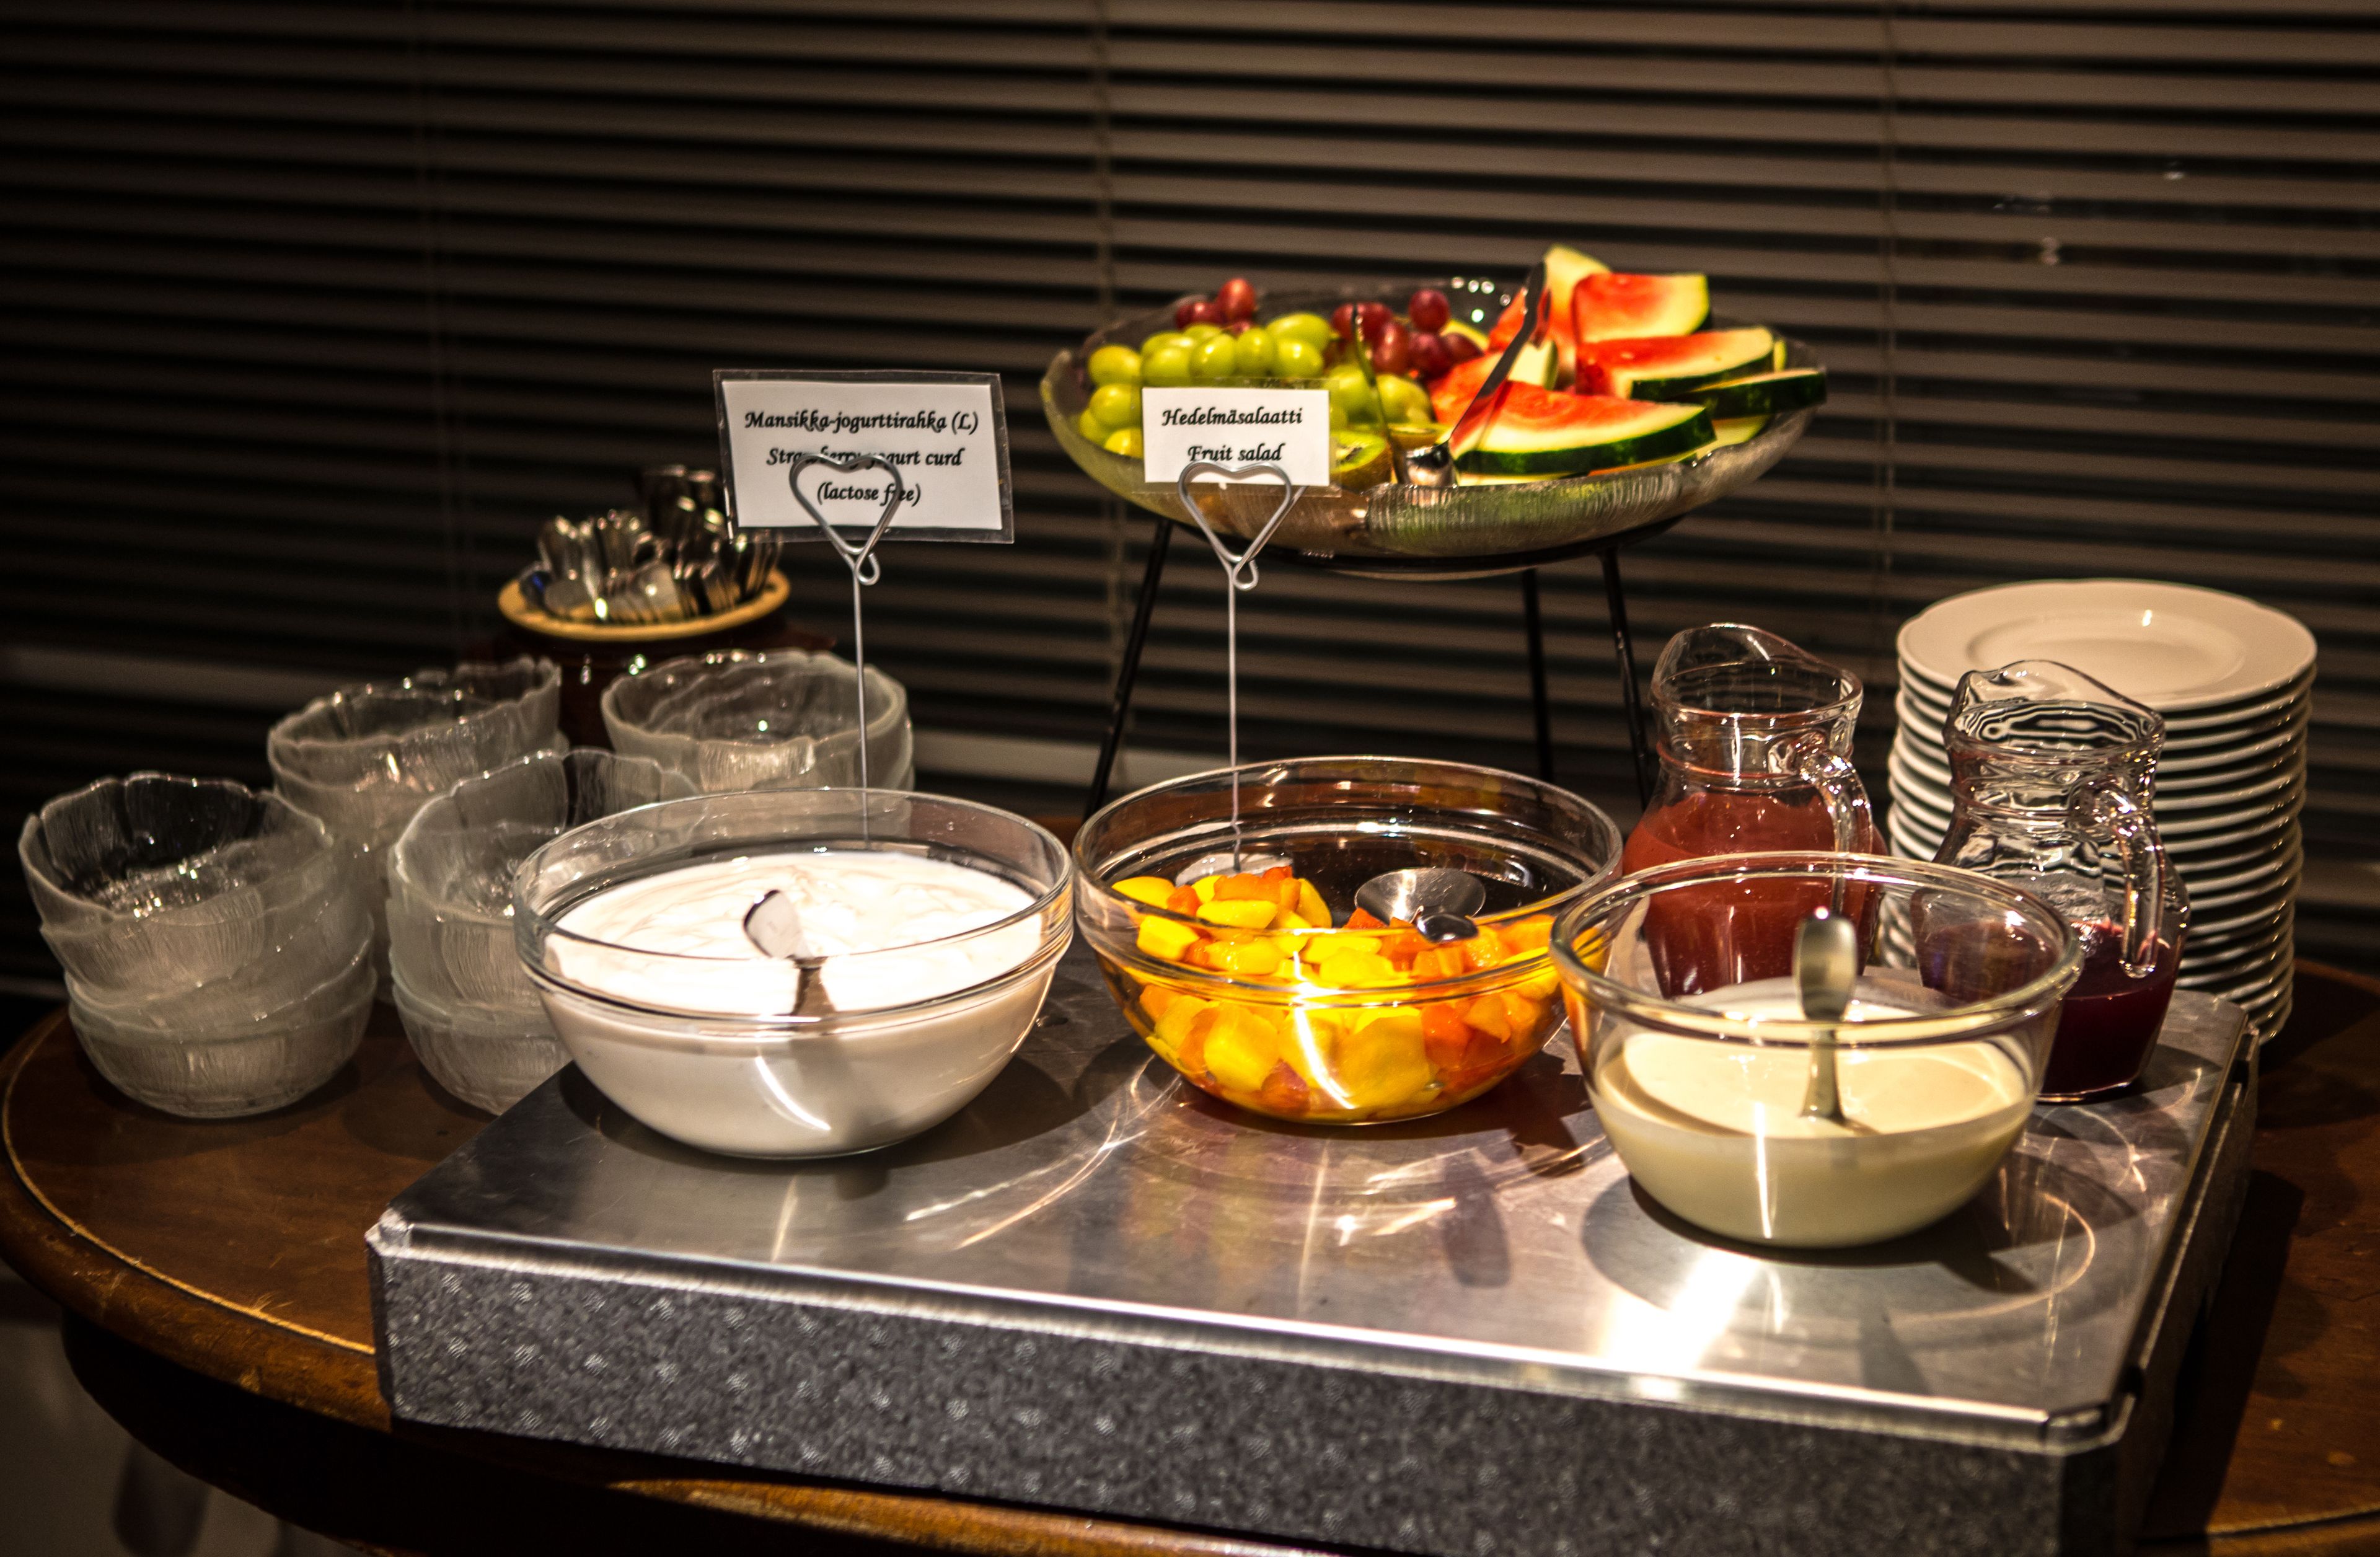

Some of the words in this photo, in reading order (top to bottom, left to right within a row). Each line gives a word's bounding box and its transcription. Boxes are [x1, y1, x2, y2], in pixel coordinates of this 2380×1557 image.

[744, 409, 948, 434] Mansikka-jogurttirahka
[951, 412, 979, 434] (L)
[1161, 407, 1303, 426] Hedelmäsalaatti
[925, 448, 965, 467] curd
[1188, 444, 1232, 462] Fruit
[1237, 443, 1286, 461] salad
[817, 482, 879, 506] (lactose
